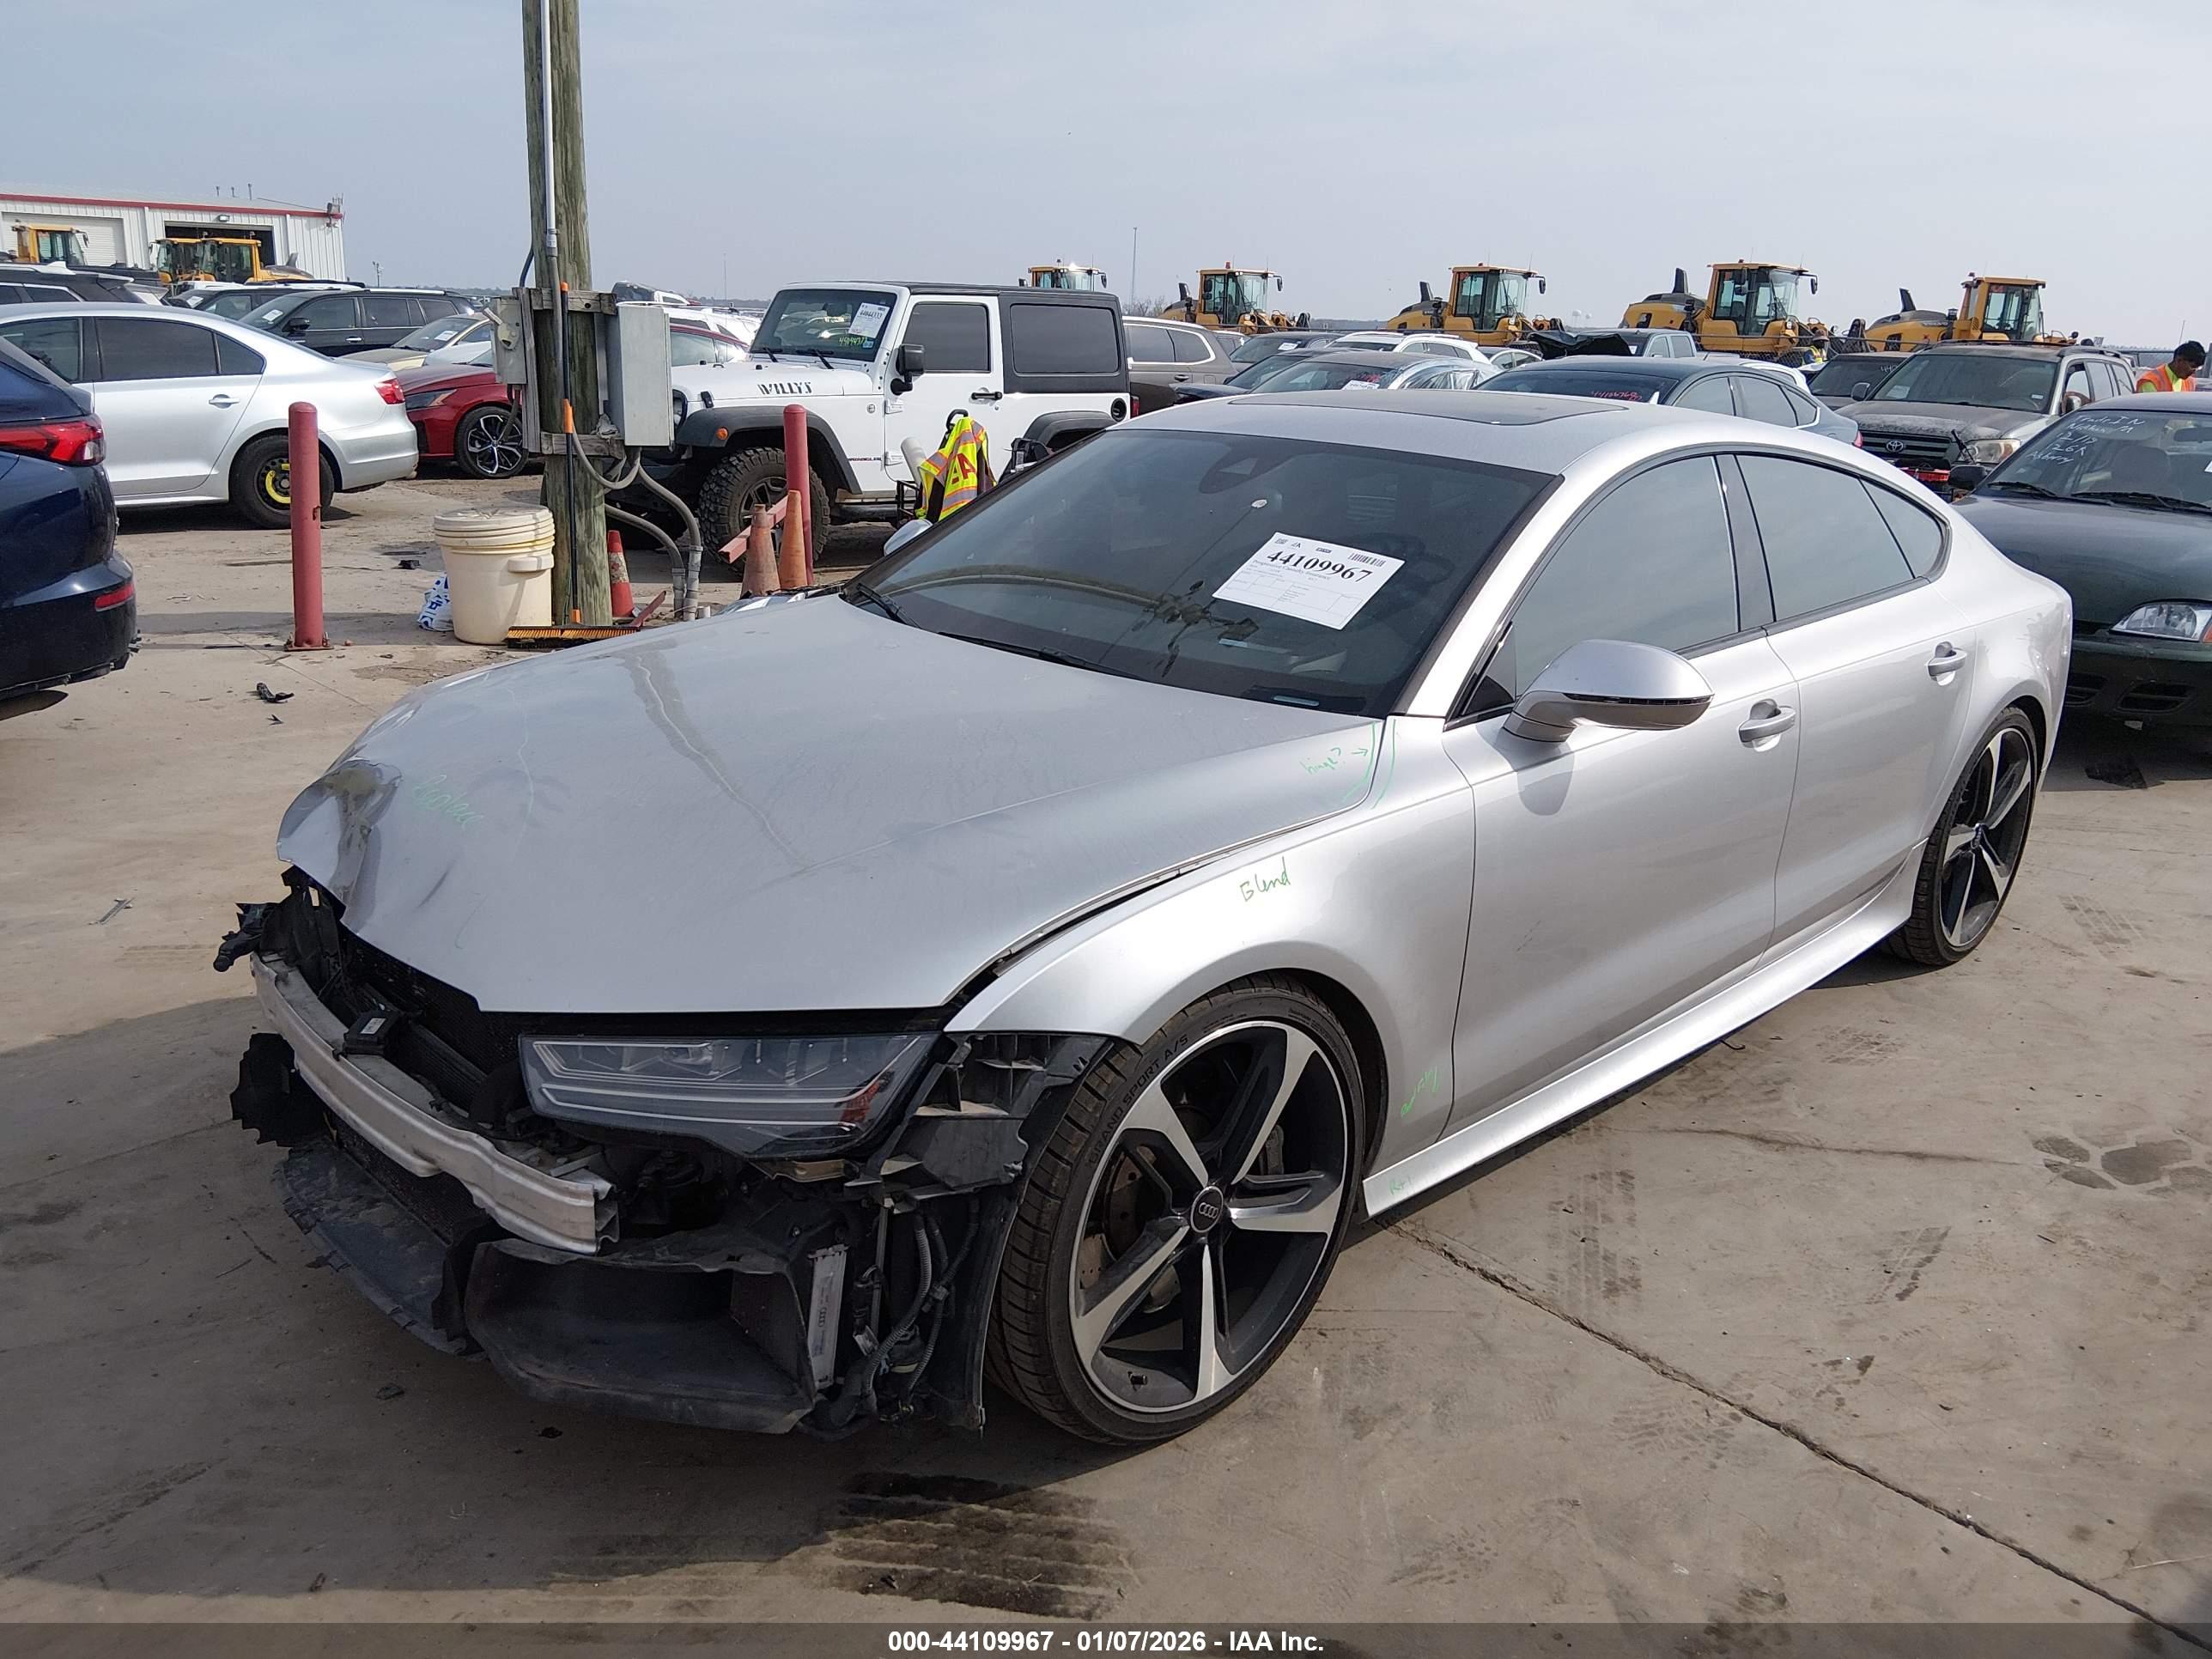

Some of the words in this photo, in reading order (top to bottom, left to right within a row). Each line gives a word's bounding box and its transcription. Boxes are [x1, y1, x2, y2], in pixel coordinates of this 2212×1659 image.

[757, 381, 812, 395] WILLYS
[1267, 550, 1373, 582] 44109967
[1122, 1060, 1161, 1106] SPORT
[1164, 1033, 1190, 1060] A/S
